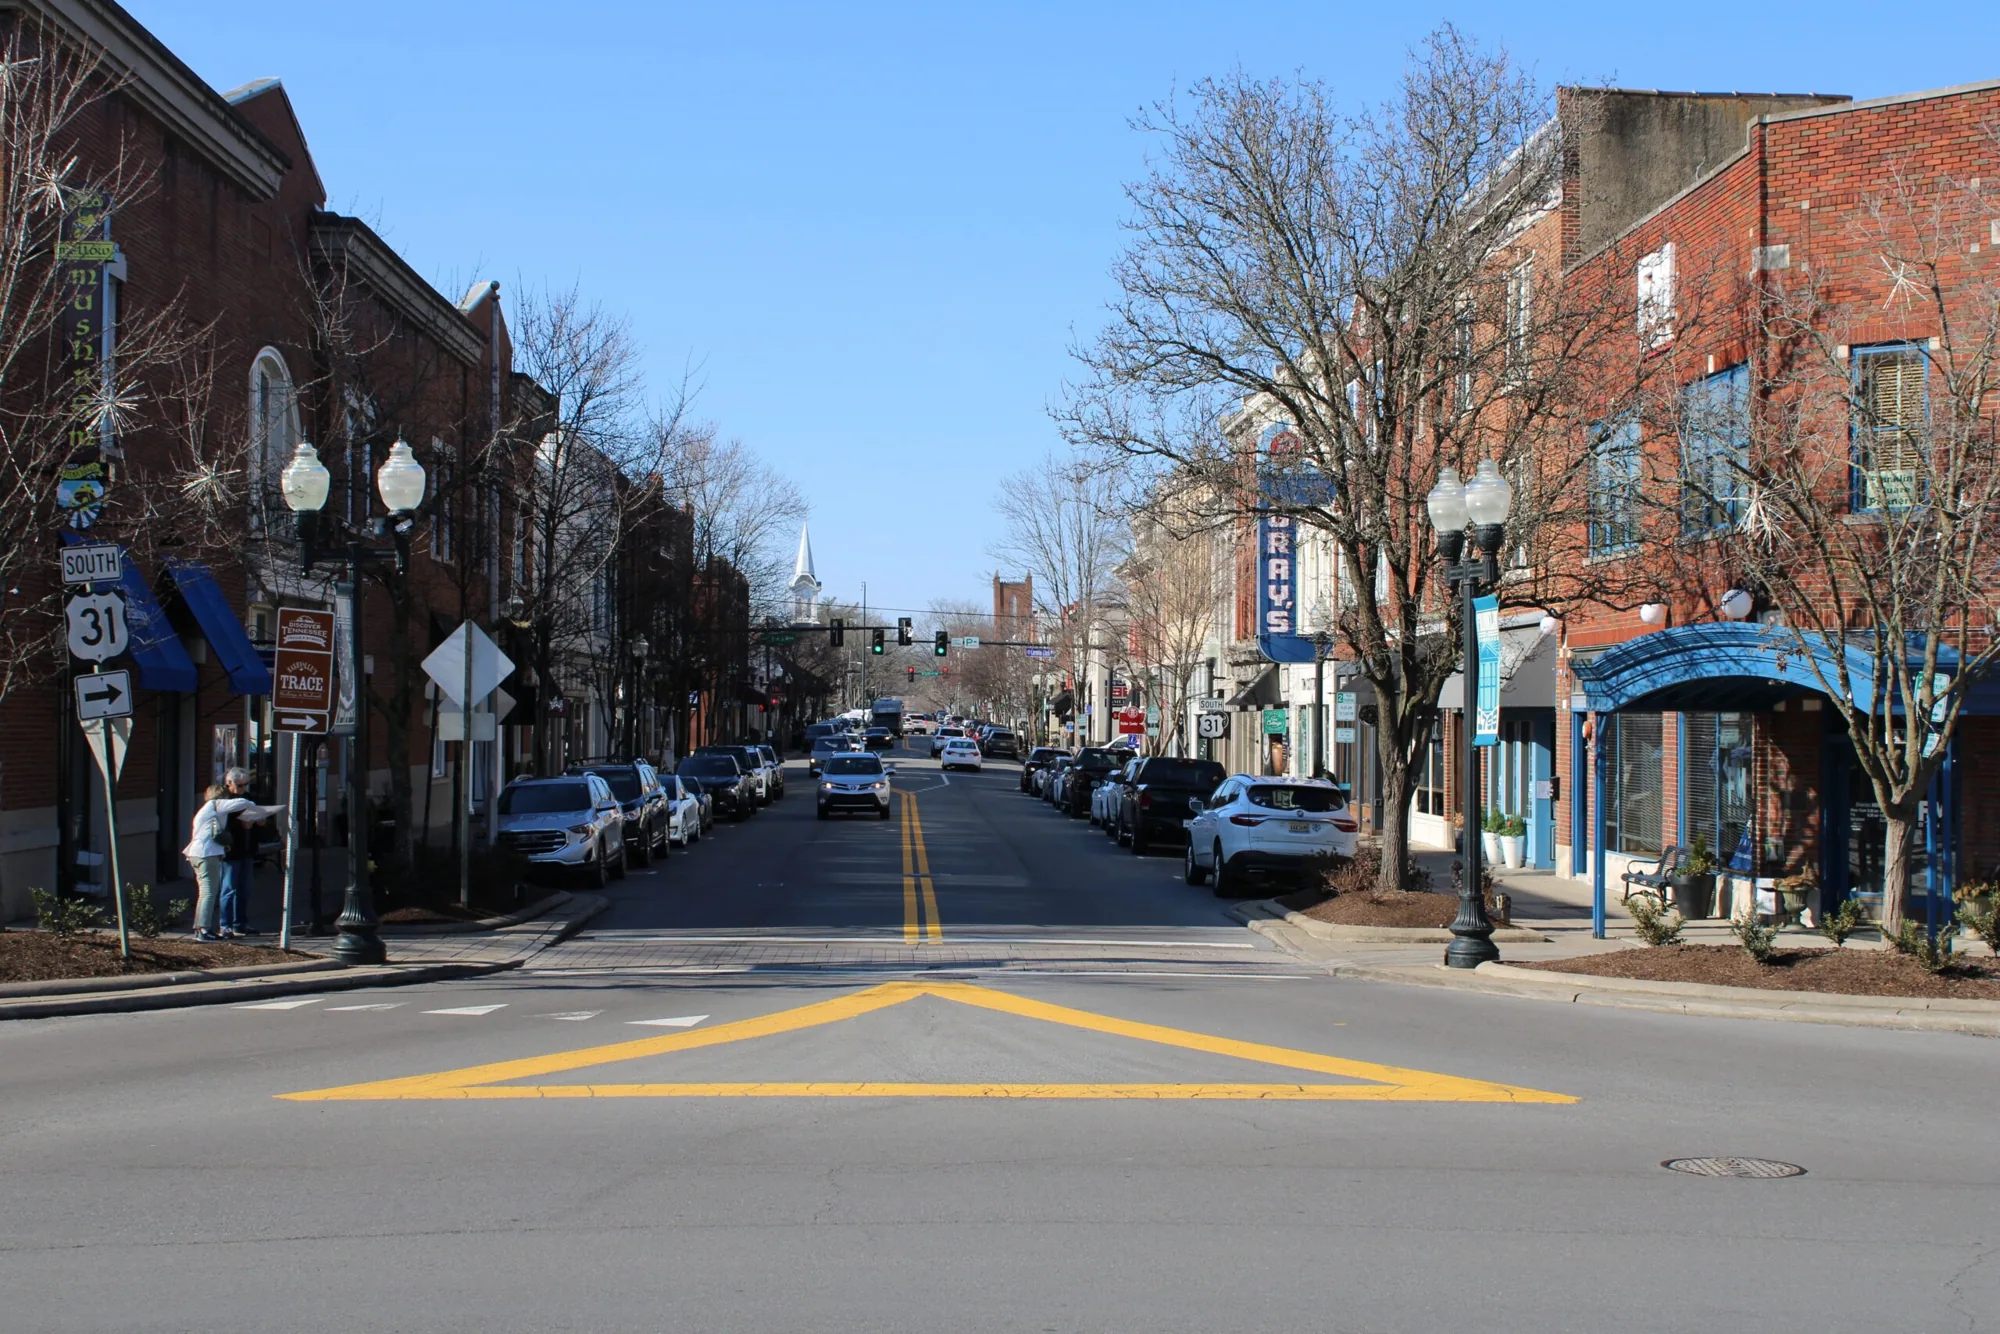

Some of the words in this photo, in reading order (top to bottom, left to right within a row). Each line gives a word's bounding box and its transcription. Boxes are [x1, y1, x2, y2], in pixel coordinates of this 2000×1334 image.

[66, 553, 117, 575] SOUTH
[80, 606, 116, 646] 31
[282, 625, 328, 639] TENNESSEE
[288, 621, 321, 630] DISCOVER
[280, 675, 324, 691] TRACE
[1200, 700, 1223, 709] SOUTH
[1338, 693, 1344, 703] 2
[1204, 718, 1218, 732] 31
